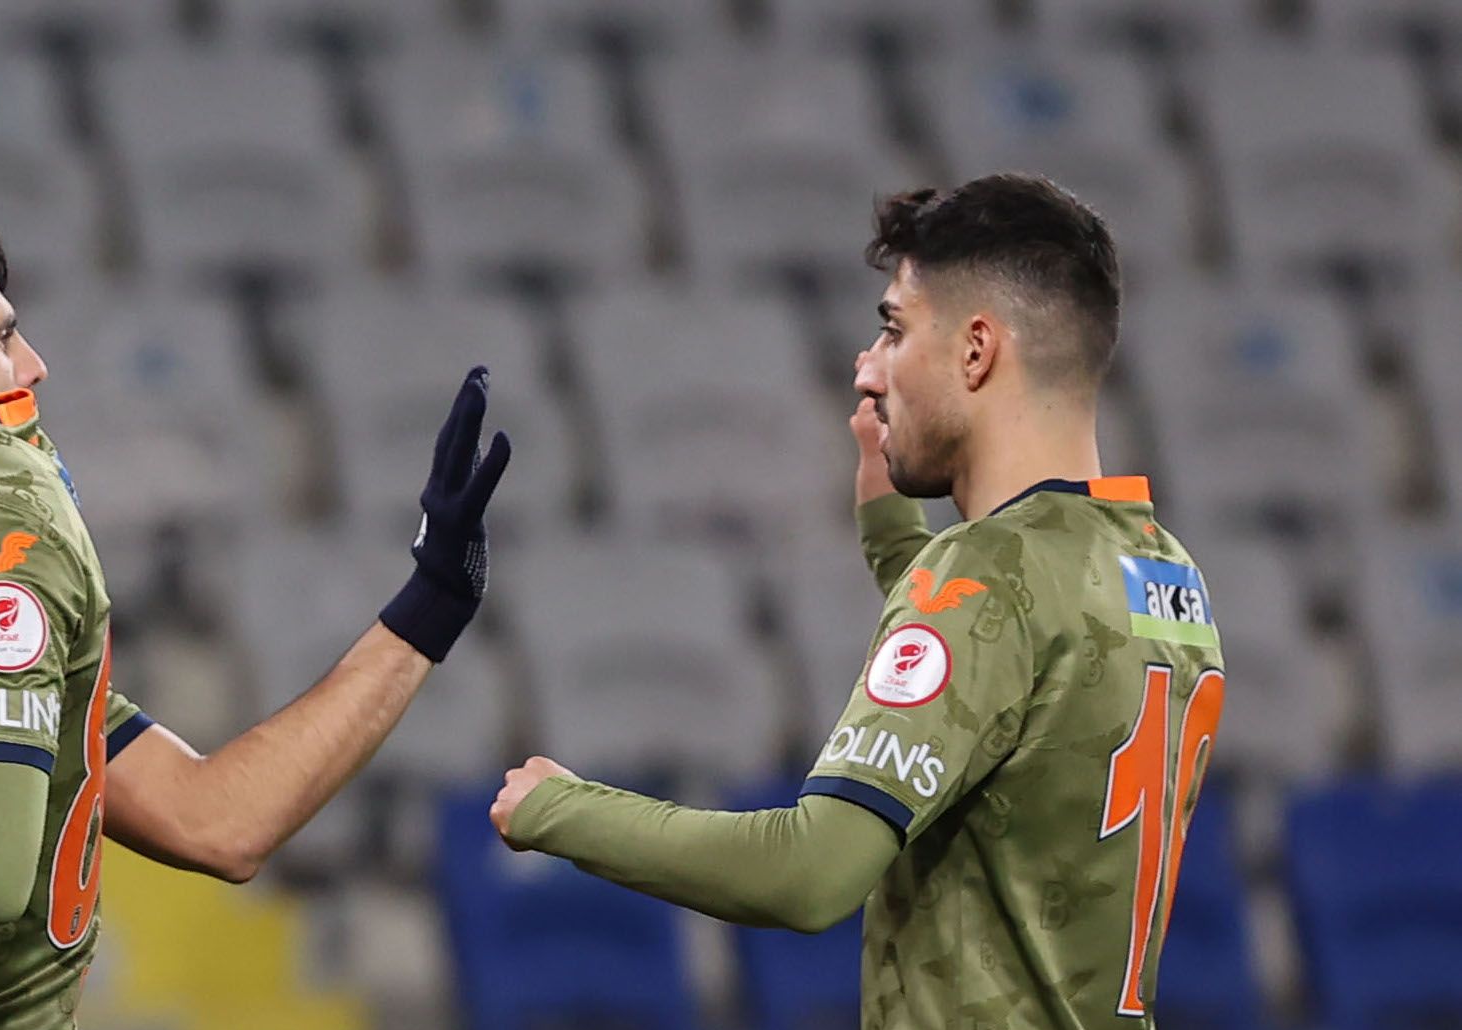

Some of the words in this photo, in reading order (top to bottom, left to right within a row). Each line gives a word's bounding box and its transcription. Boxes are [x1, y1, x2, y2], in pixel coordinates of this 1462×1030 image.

[1146, 581, 1206, 625] aksa
[826, 726, 945, 797] OLIN'S
[1098, 662, 1225, 1017] 10
